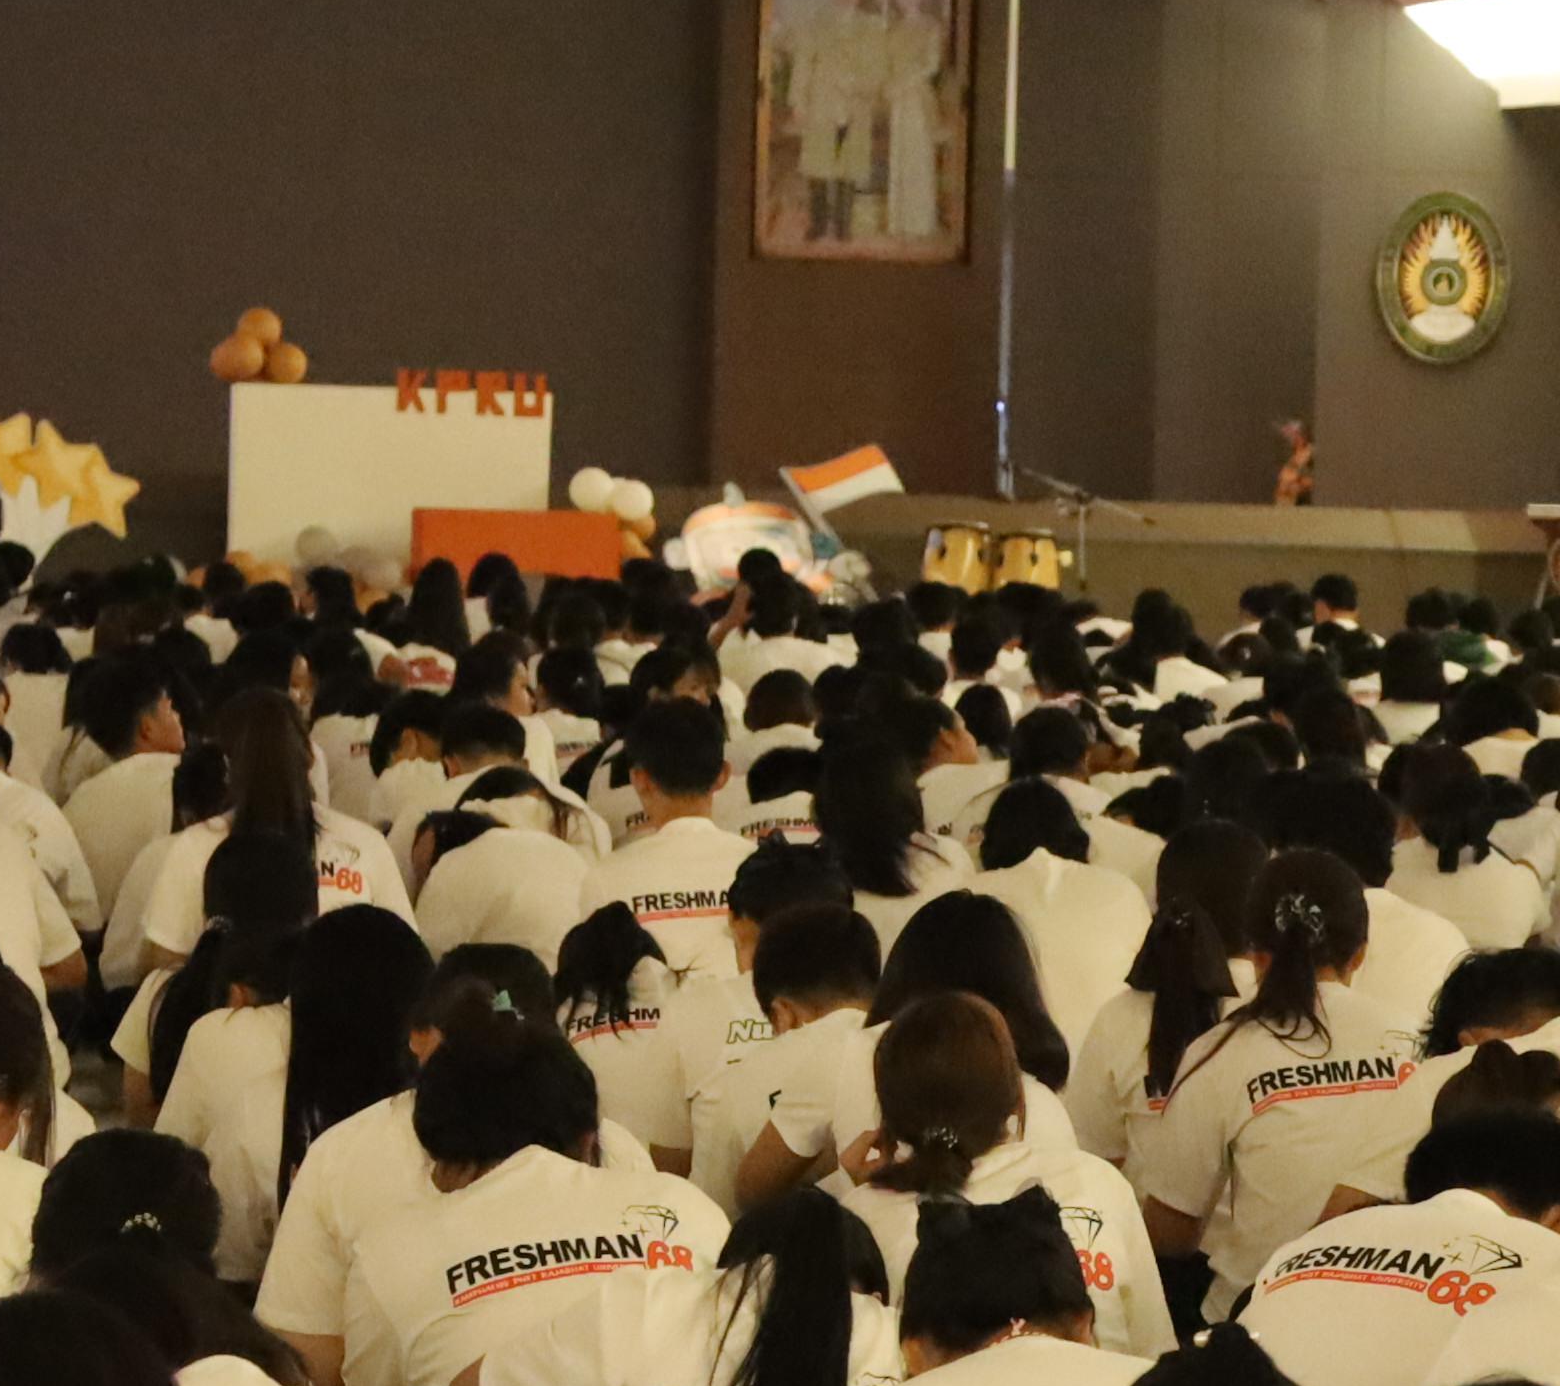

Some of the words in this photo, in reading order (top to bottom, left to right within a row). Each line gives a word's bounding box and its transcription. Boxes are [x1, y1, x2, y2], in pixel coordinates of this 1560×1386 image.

[396, 369, 547, 417] KPRU
[632, 891, 728, 913] FRESHMA
[1247, 1057, 1396, 1104] FRESHMAN
[446, 1234, 643, 1295] FRESHMAN
